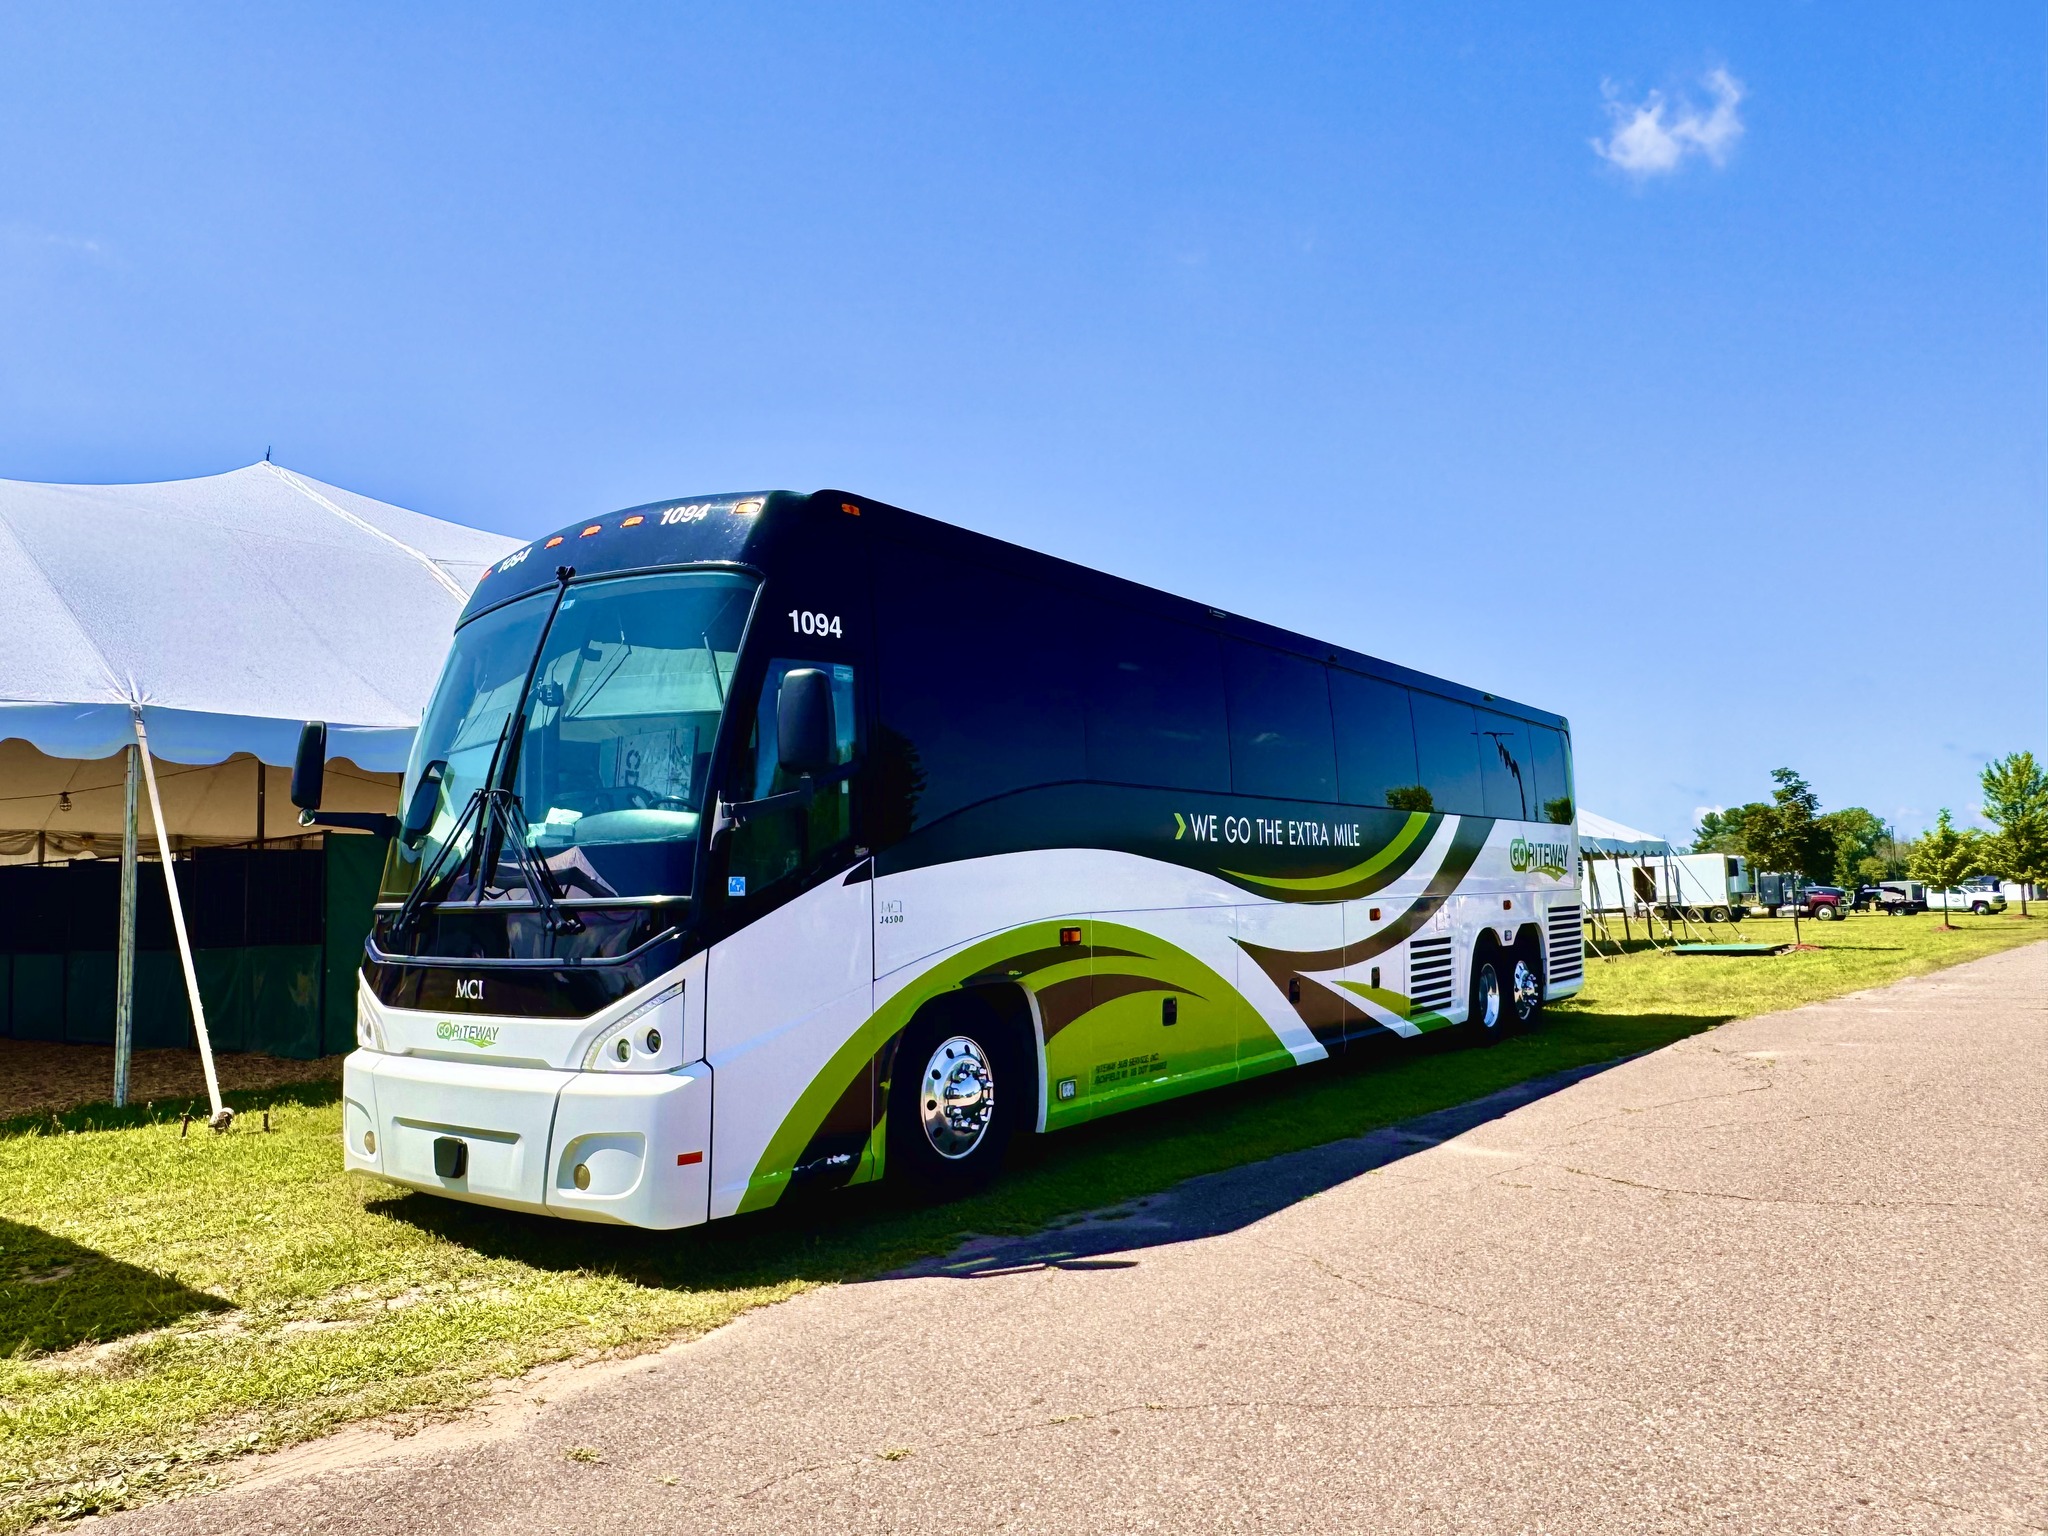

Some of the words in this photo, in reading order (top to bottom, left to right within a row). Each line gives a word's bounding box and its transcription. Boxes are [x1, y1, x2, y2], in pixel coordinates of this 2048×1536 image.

[660, 503, 711, 525] 1094
[788, 609, 843, 639] 1094
[1189, 813, 1218, 842] WE
[1224, 815, 1251, 844] GO
[1256, 818, 1284, 845] THE
[1288, 820, 1330, 847] EXTRA
[1334, 823, 1361, 847] MILE
[879, 915, 904, 924] J4500
[455, 978, 484, 1000] MCI
